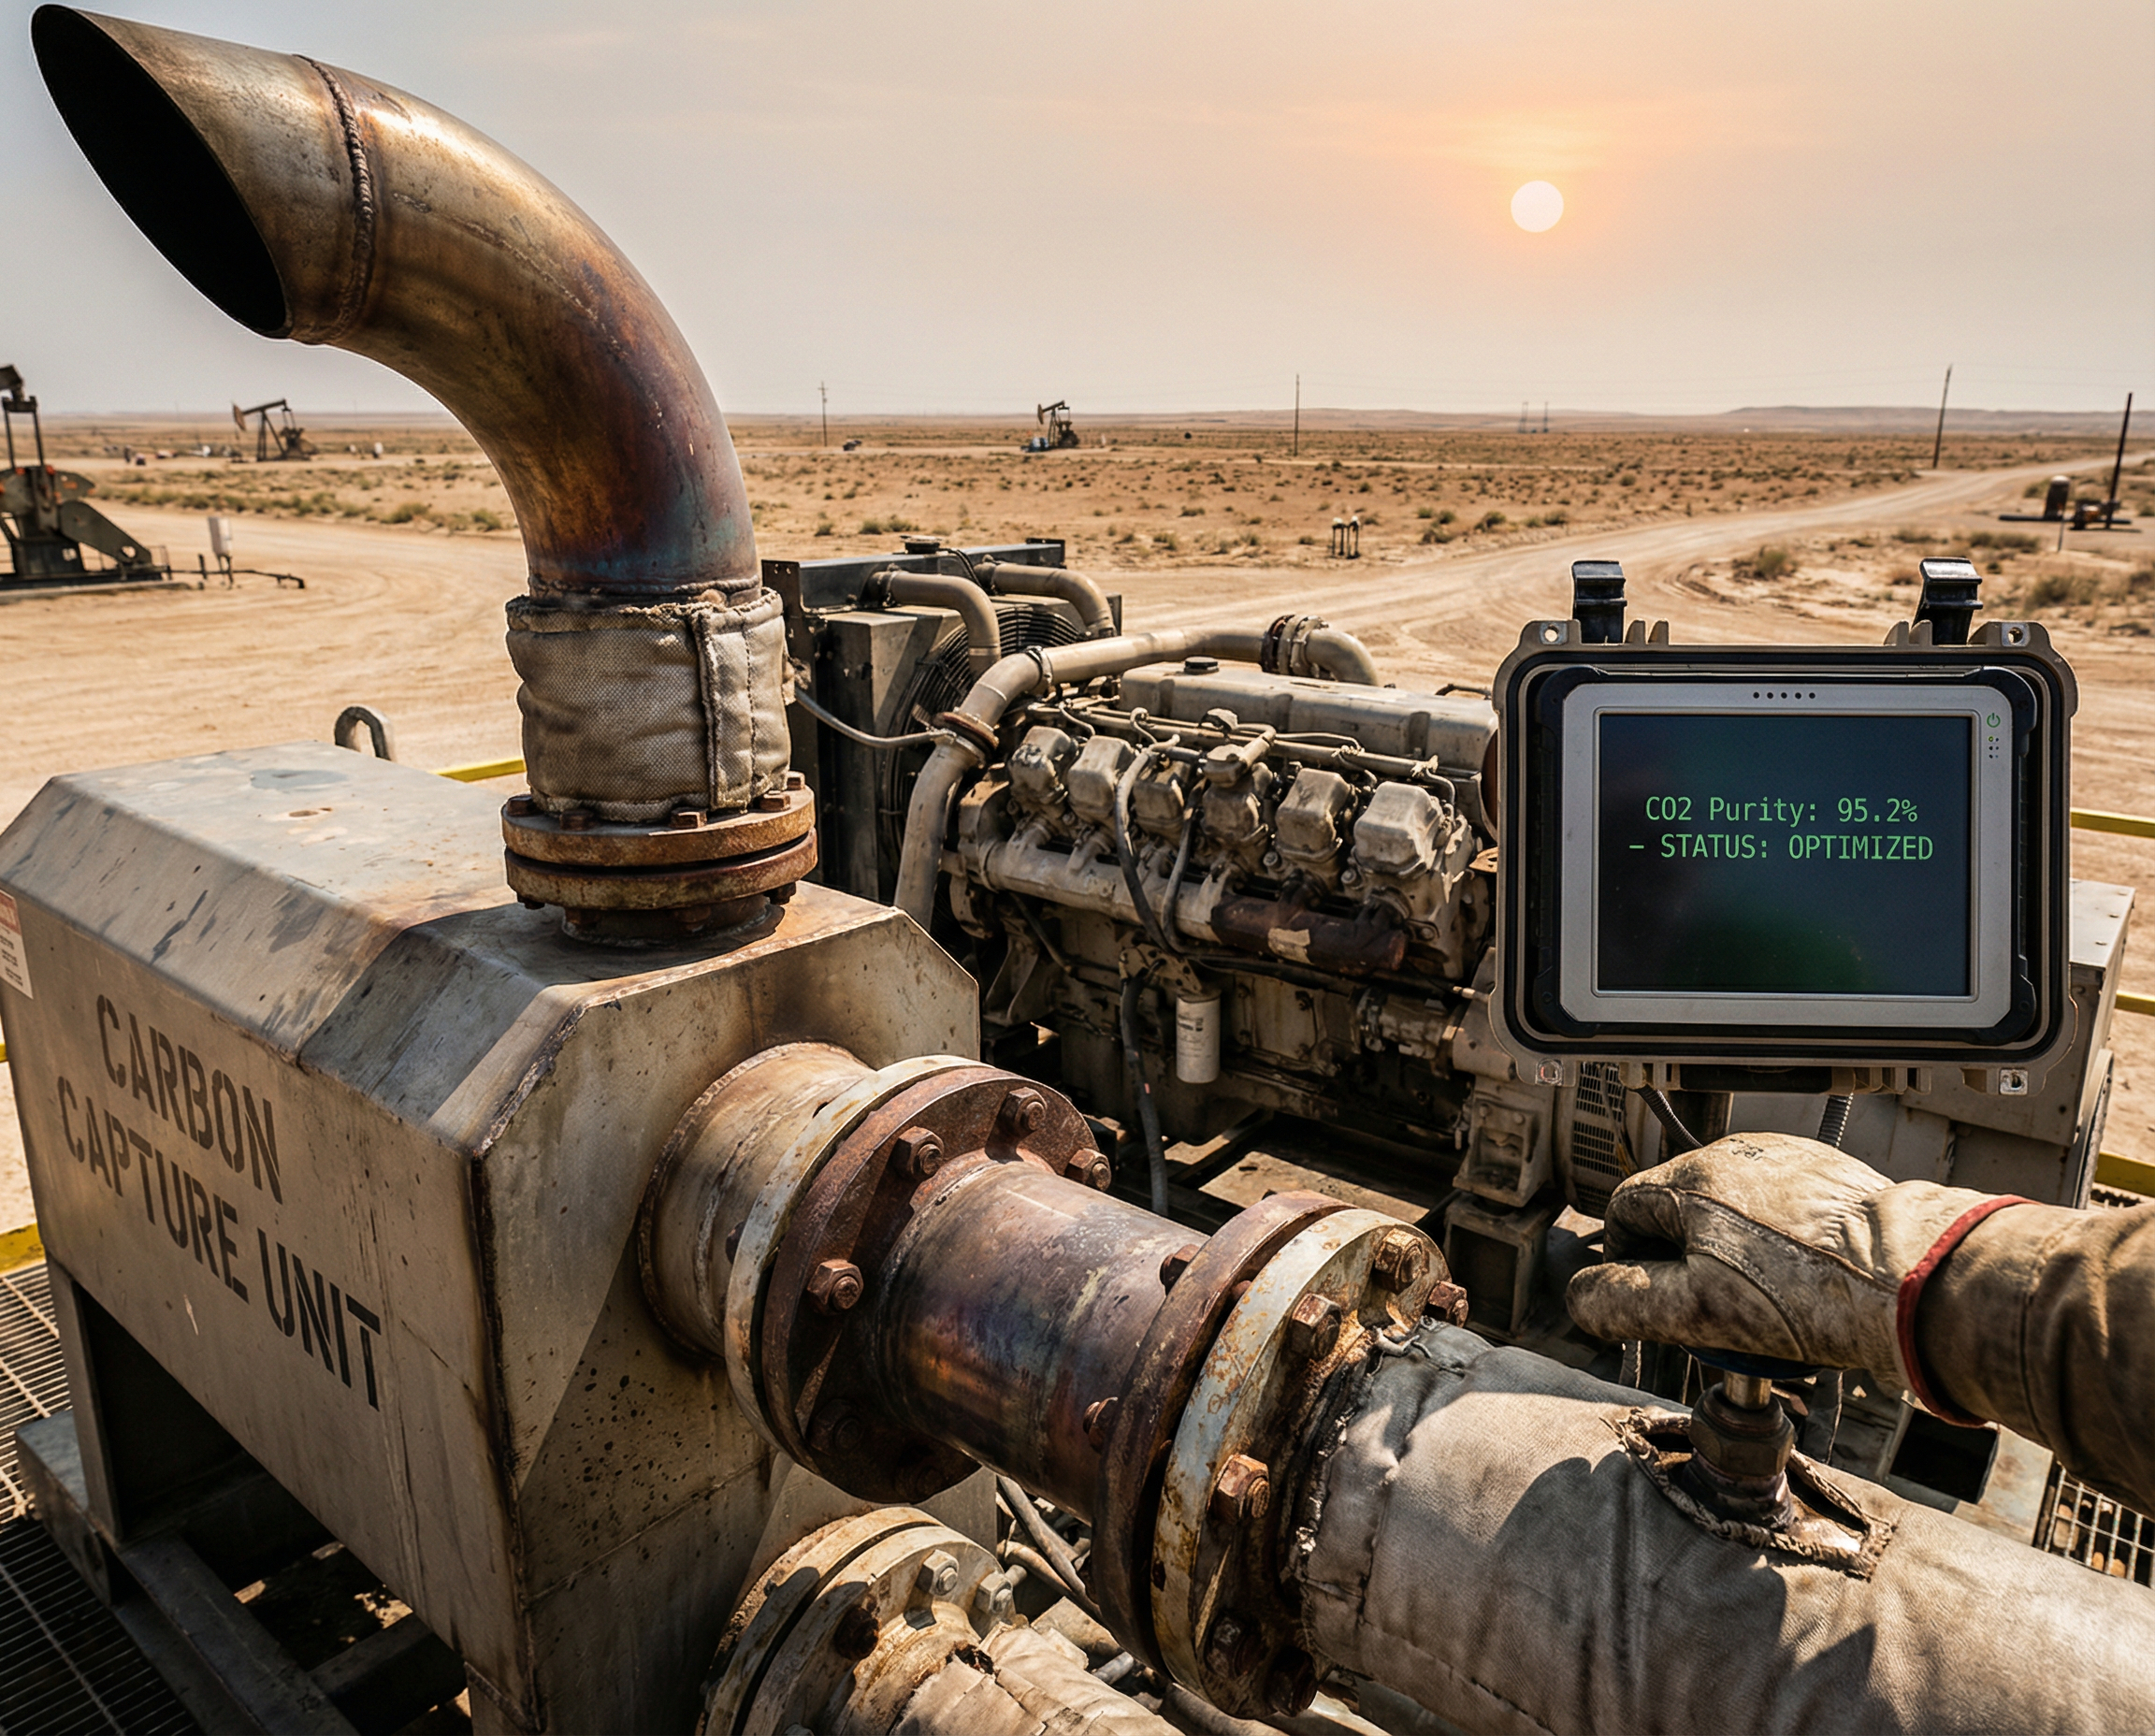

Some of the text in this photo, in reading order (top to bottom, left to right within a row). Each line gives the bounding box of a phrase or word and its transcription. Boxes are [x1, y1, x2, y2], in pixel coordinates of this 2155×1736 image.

[1645, 796, 1918, 827] CO2 Purity: 95.2%
[1660, 833, 1768, 859] STATUS:
[1788, 834, 1933, 860] OPTIMIZED
[96, 994, 282, 1205] CARBON
[57, 1076, 382, 1411] CAPTURE UNIT
